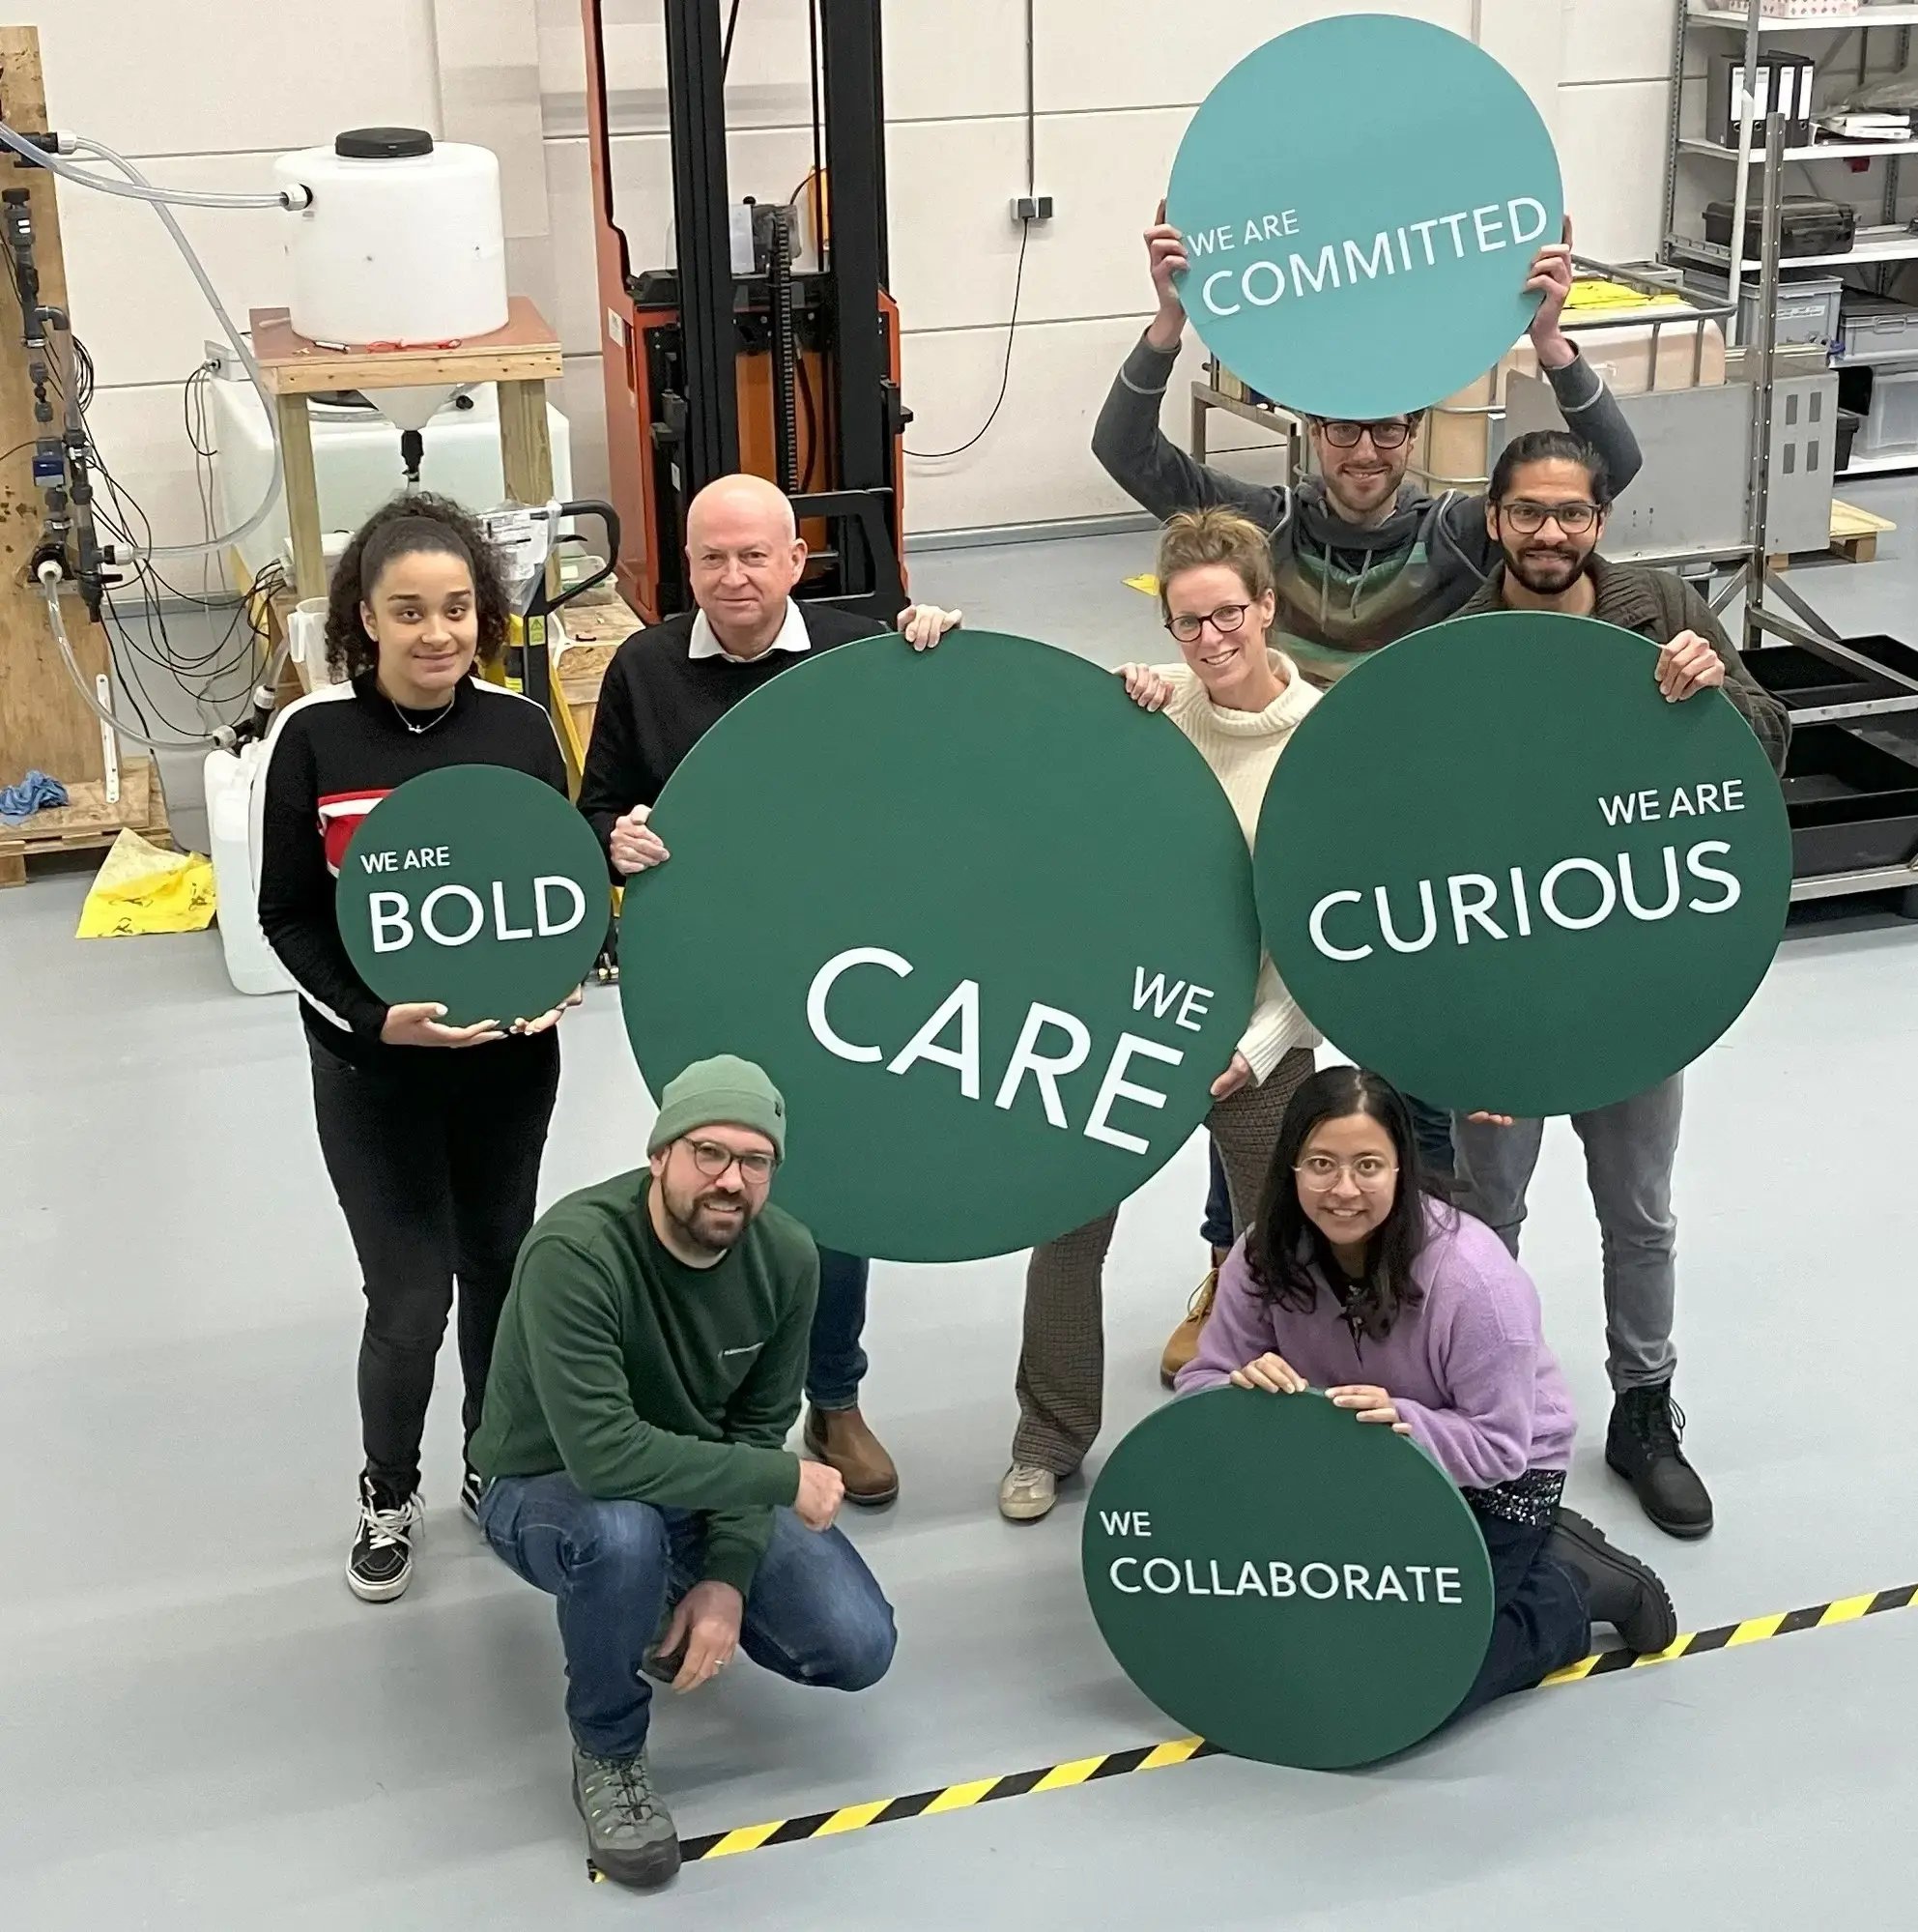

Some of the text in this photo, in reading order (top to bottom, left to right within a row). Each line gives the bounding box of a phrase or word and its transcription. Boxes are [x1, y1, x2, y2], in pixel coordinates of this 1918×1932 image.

[1187, 209, 1301, 258] WE ARE
[1201, 197, 1548, 317] COMMITTED
[1598, 779, 1746, 827] WE ARE
[360, 846, 450, 874] WE ARE
[368, 875, 587, 954] BOLD
[1308, 840, 1742, 962] CURIOUS
[1131, 965, 1216, 1032] WE
[806, 946, 1186, 1156] CARE
[1099, 1510, 1153, 1538] WE
[1109, 1556, 1463, 1604] COLLABORATE
